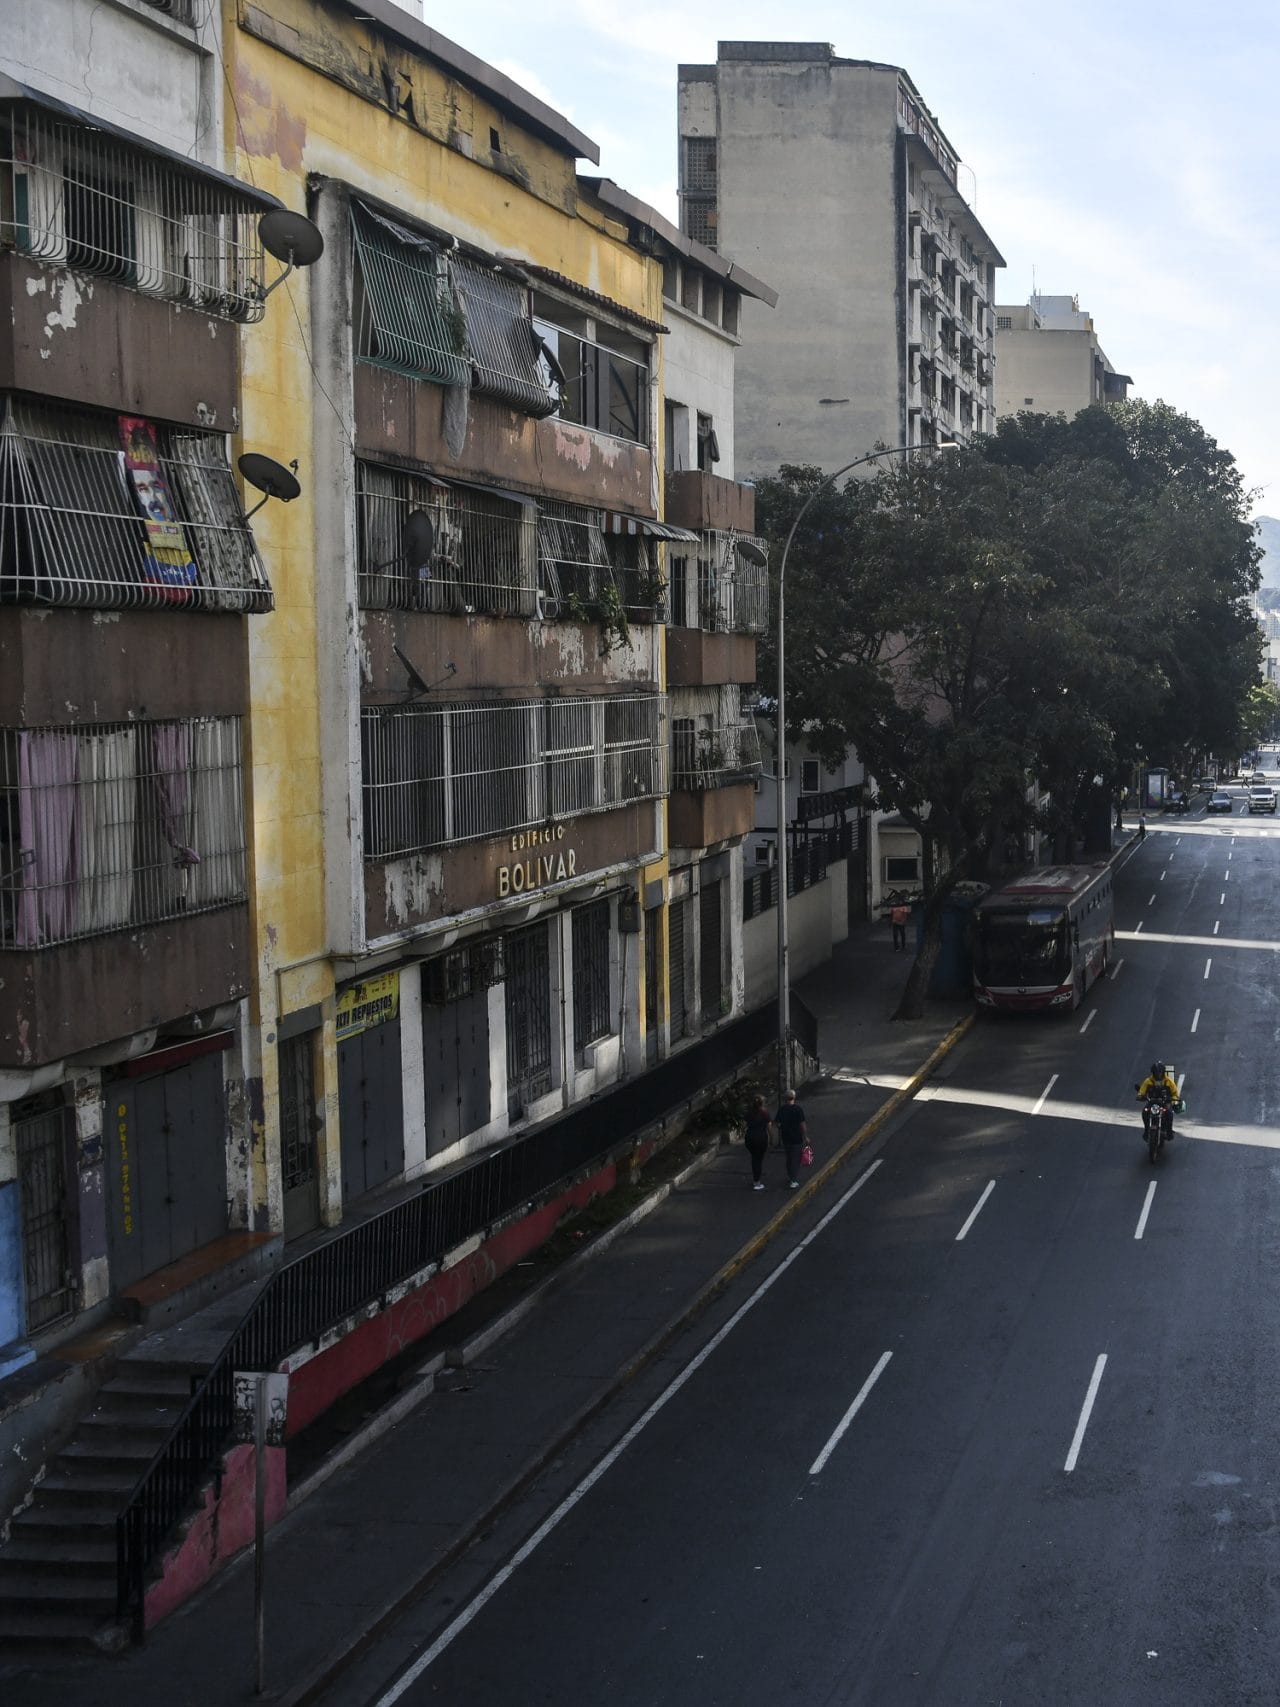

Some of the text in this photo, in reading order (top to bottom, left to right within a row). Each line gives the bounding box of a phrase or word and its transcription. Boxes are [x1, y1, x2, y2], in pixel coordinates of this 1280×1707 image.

[512, 825, 563, 851] EDIFICIO
[498, 848, 576, 897] BOLIVAR
[351, 993, 393, 1024] REPUESTOS
